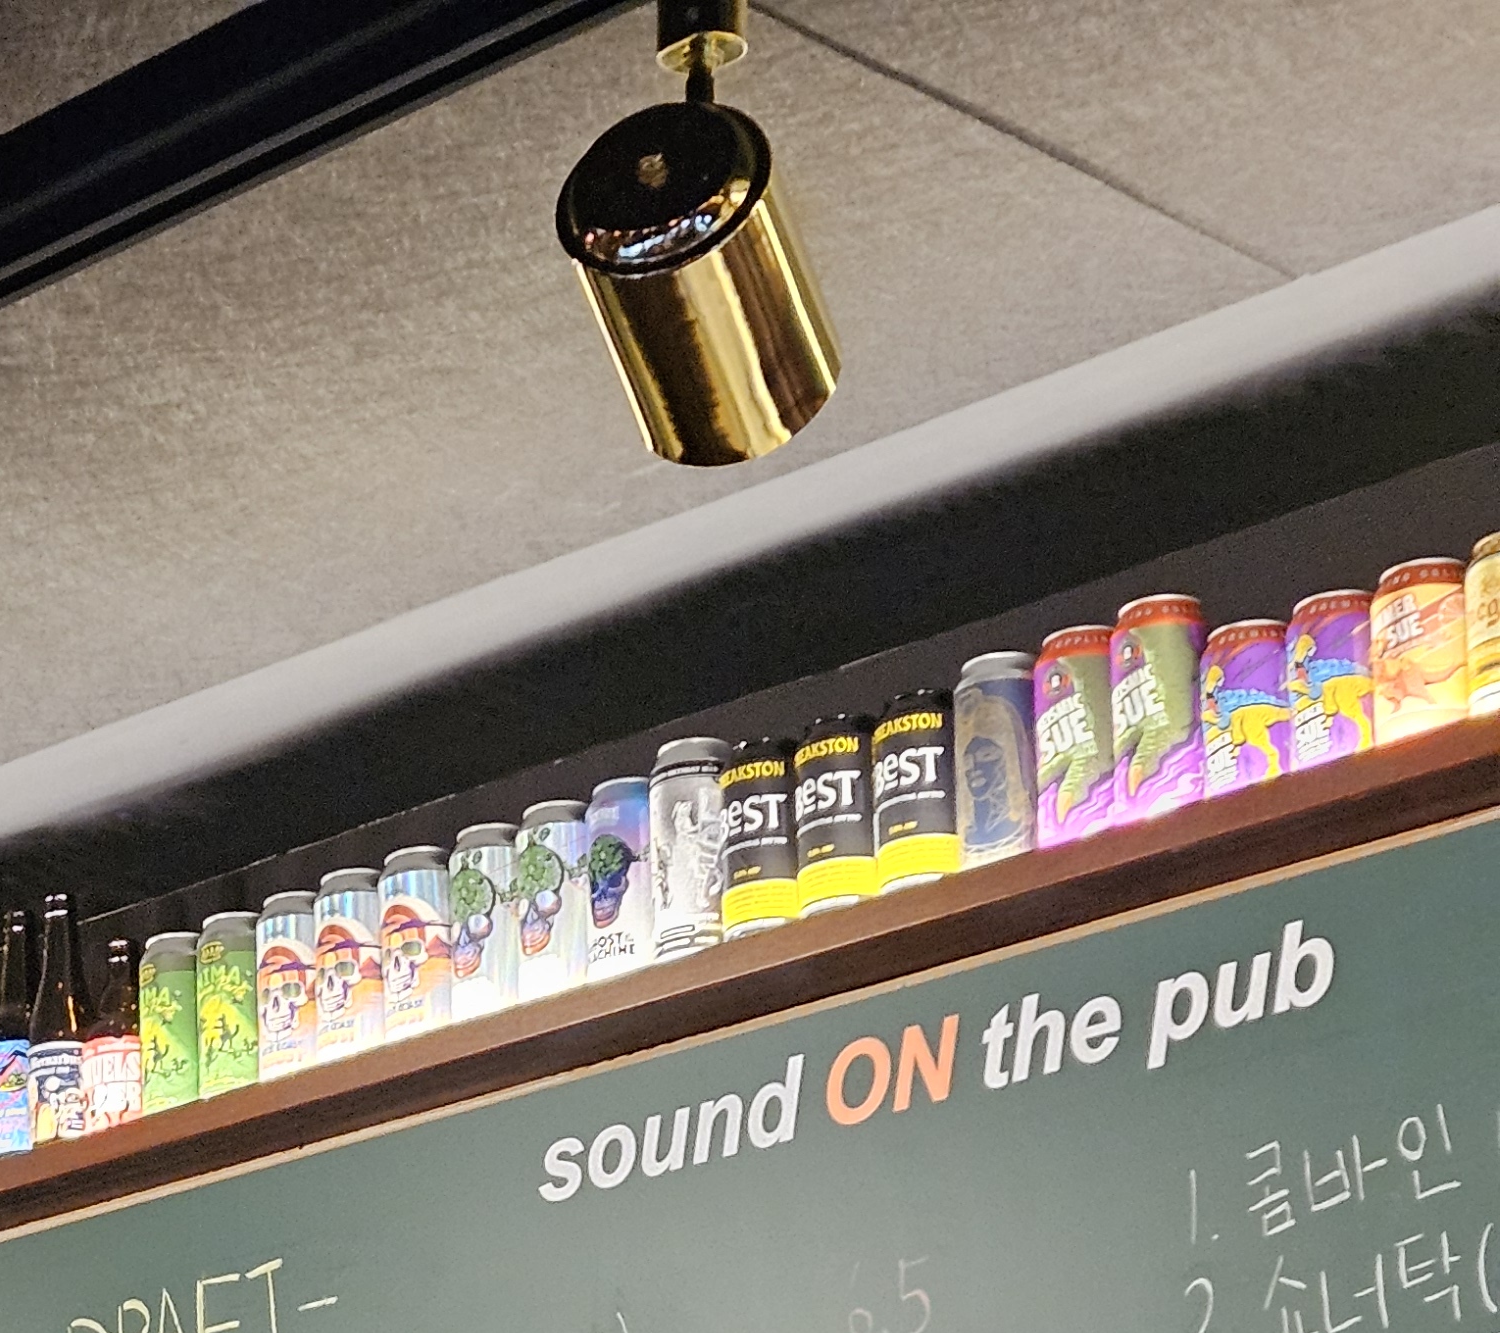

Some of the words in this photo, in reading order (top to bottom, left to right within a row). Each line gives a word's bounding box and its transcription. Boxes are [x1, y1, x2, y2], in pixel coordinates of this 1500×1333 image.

[1040, 708, 1094, 764] SUE
[1112, 675, 1165, 739] SUE
[537, 1053, 806, 1203] sound
[825, 1014, 961, 1126] ON
[980, 993, 1124, 1091] the
[1146, 919, 1337, 1069] pub
